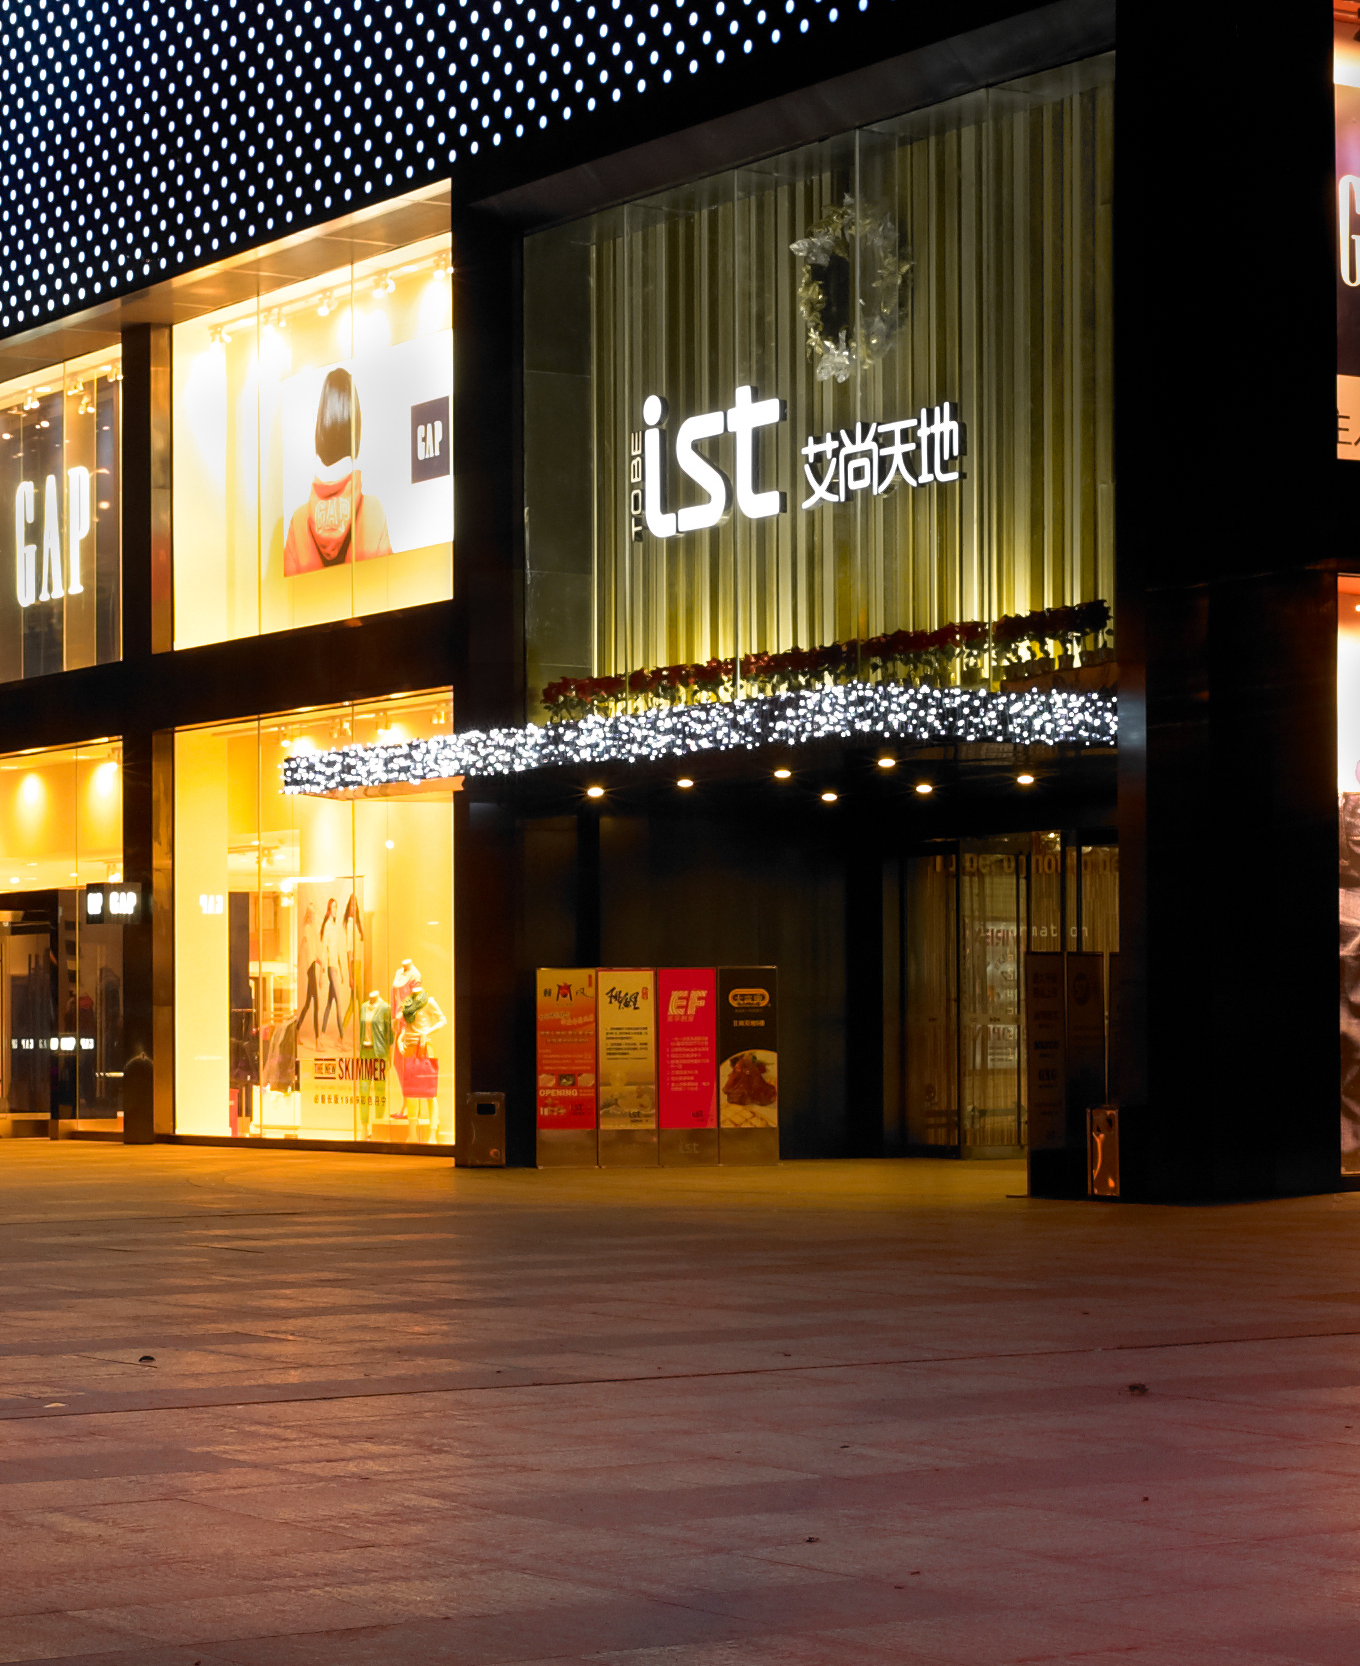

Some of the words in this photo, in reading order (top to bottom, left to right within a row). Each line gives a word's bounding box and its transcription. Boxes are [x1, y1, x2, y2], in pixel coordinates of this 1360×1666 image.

[416, 420, 444, 461] GAP
[642, 385, 782, 537] ist
[800, 401, 960, 510] 艾尚天地
[314, 496, 351, 535] GAP
[15, 465, 91, 608] GAP
[109, 891, 137, 915] GAP
[667, 990, 708, 1015] EF
[338, 1058, 386, 1081] SKIMMER
